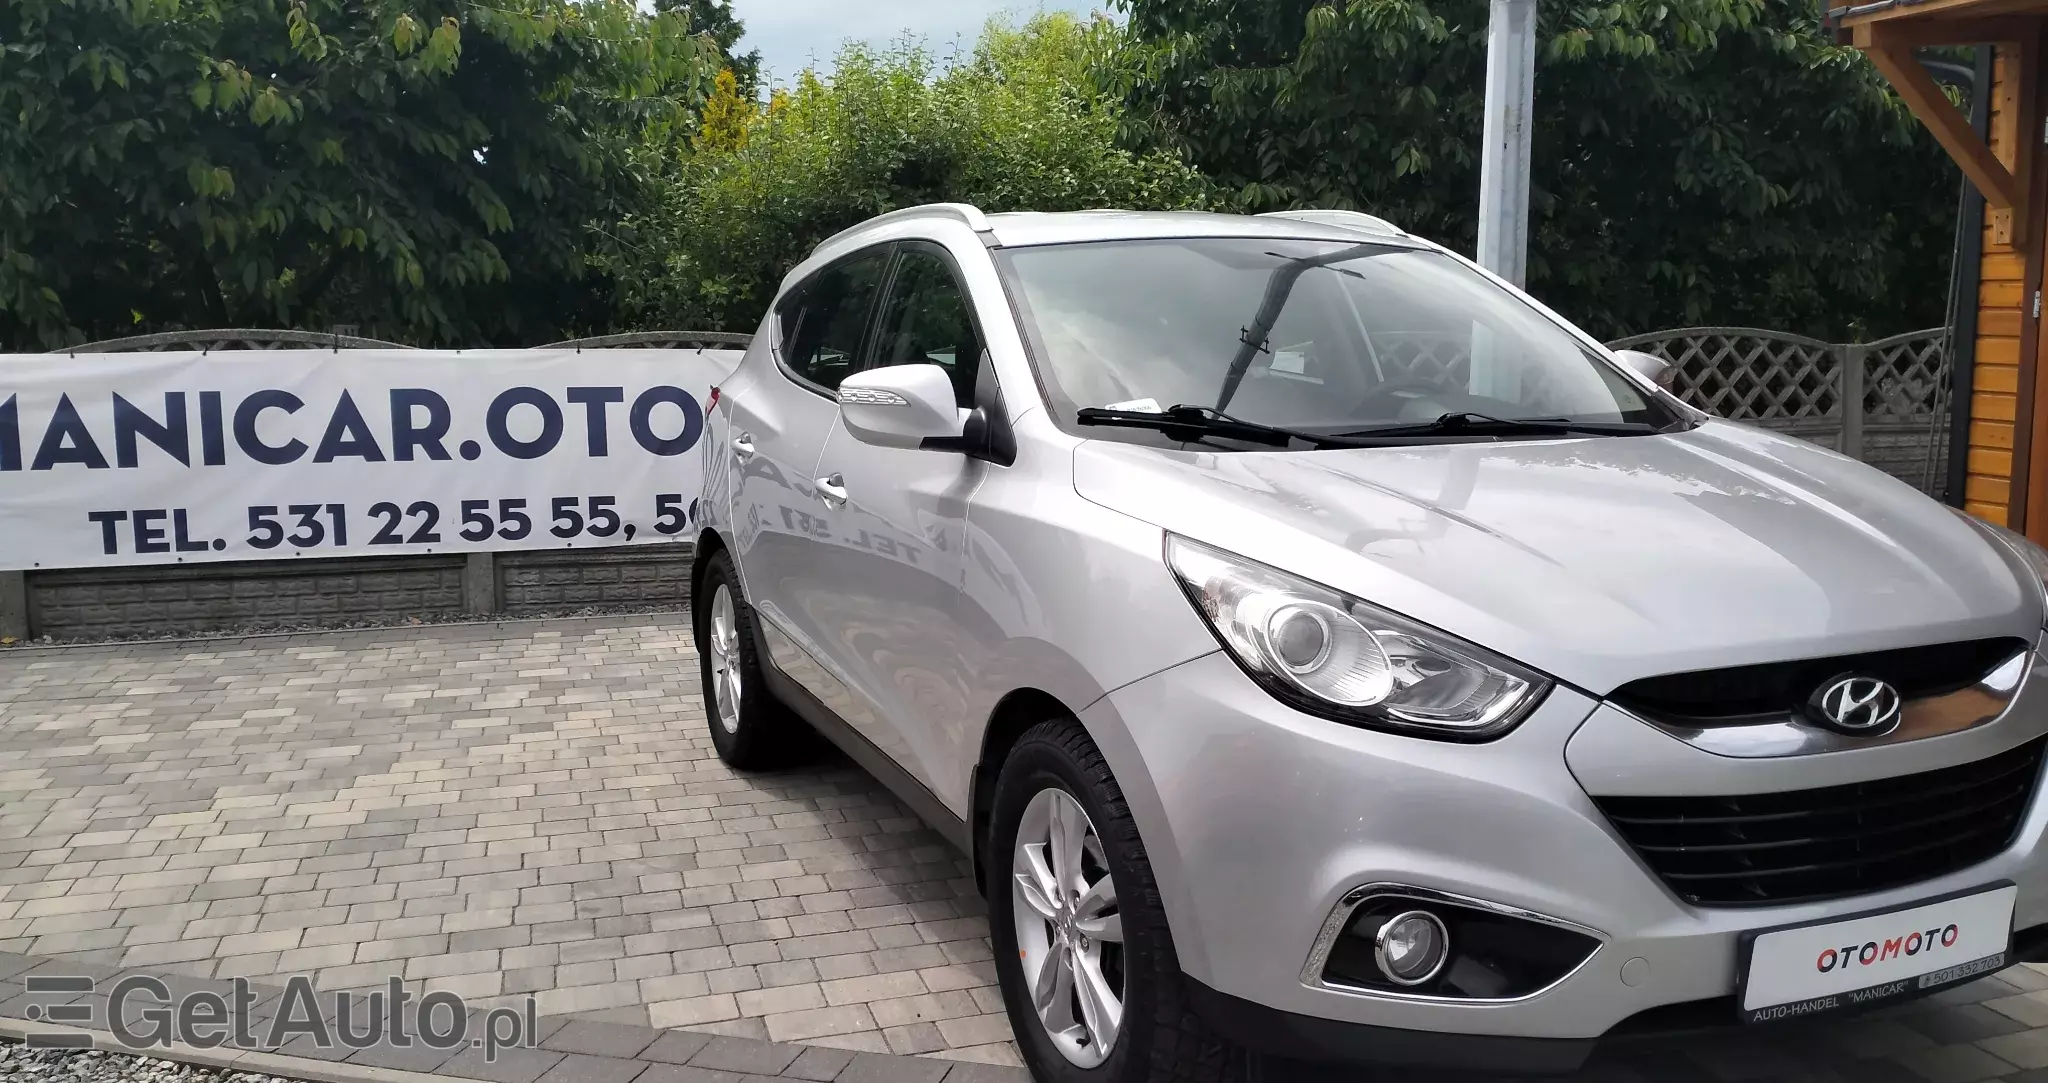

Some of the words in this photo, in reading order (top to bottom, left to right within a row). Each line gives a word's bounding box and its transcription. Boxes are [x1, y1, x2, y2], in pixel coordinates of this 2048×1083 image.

[88, 509, 227, 555] TEL.
[246, 503, 346, 549] 531
[367, 500, 440, 545] 22
[459, 497, 531, 541] 55
[549, 495, 637, 542] 55,
[1816, 923, 1959, 973] OTOMOTO
[1934, 969, 1955, 984] 501
[1957, 962, 1979, 978] 332
[1980, 955, 2001, 970] 703
[1752, 996, 1840, 1022] AUTO-HANDEL
[1848, 980, 1909, 1003] "MANICAR"
